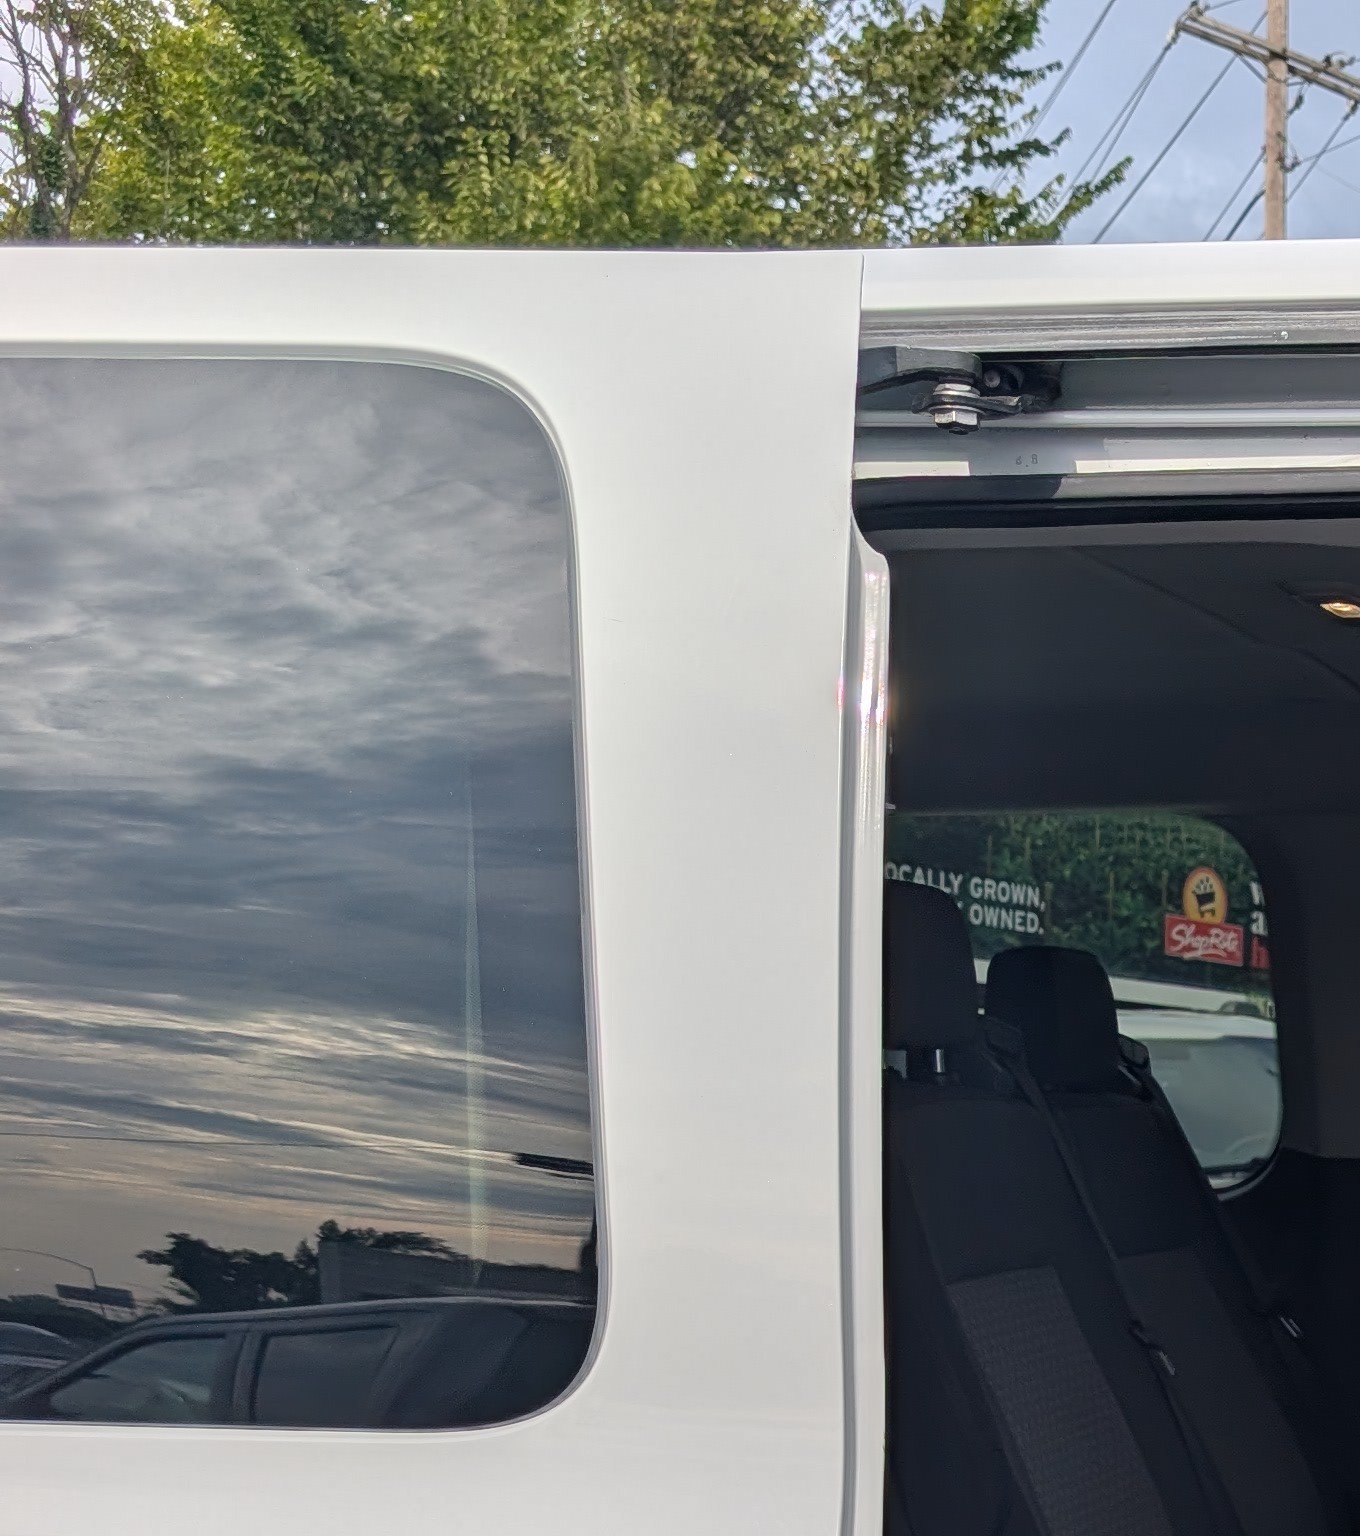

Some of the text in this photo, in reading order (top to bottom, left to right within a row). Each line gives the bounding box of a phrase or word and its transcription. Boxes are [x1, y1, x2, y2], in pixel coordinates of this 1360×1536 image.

[885, 861, 1046, 912] OCALLY GROWN,
[969, 903, 1045, 935] OWNED.
